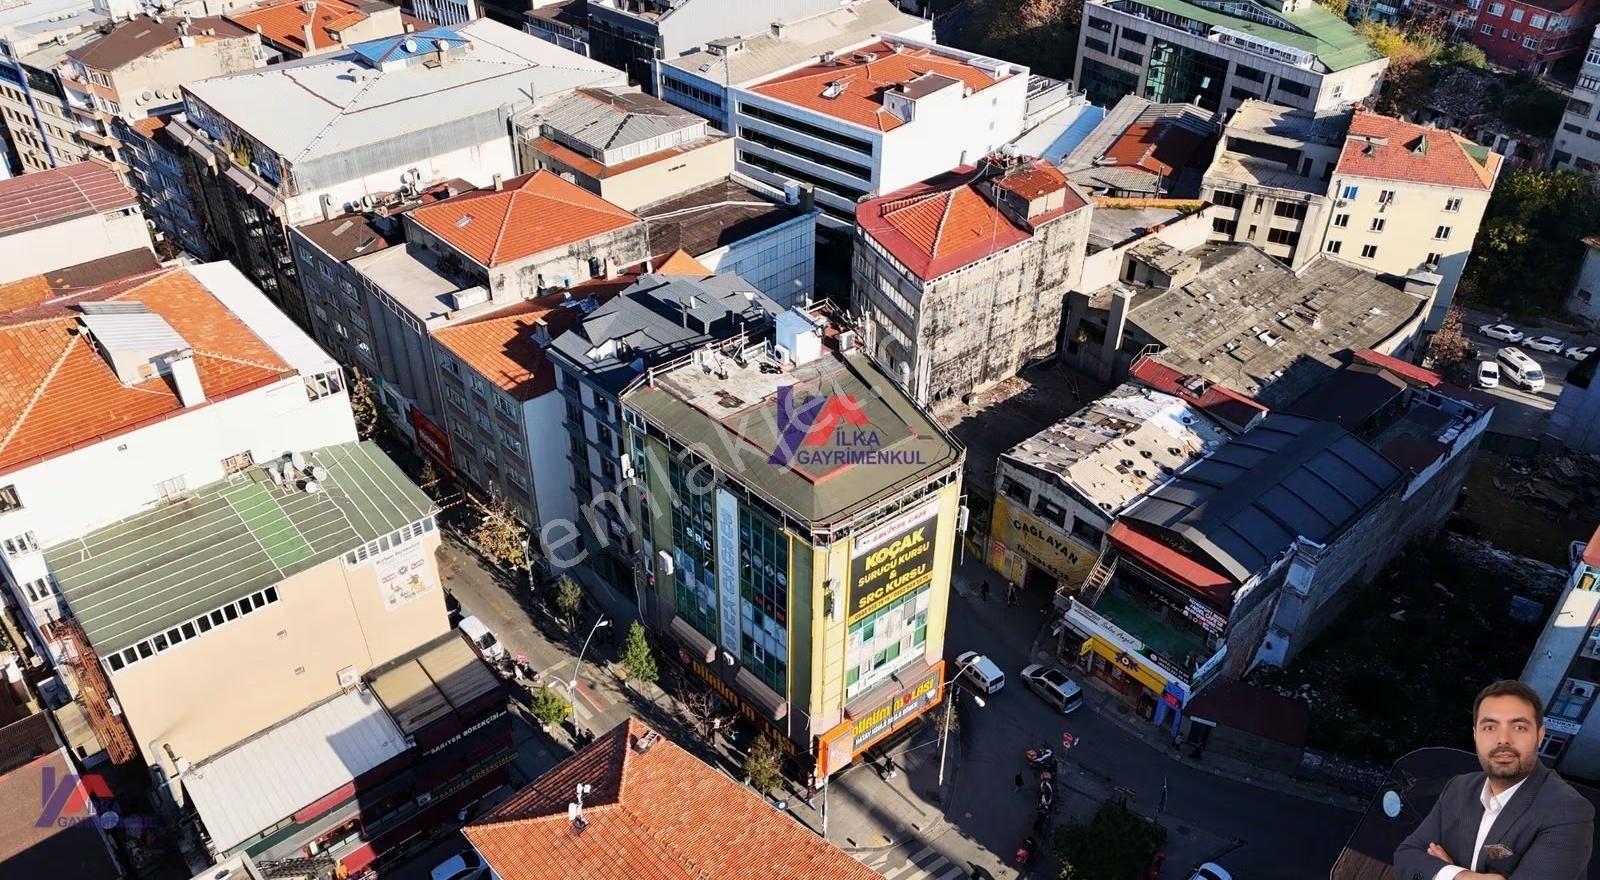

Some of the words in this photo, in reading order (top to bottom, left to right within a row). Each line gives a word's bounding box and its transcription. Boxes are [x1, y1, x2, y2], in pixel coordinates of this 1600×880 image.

[686, 527, 711, 551] SRC
[865, 527, 926, 571] KOÇAK
[898, 541, 930, 566] KURSU
[858, 587, 884, 609] SRC
[885, 563, 926, 593] KURSU
[889, 569, 897, 579] &
